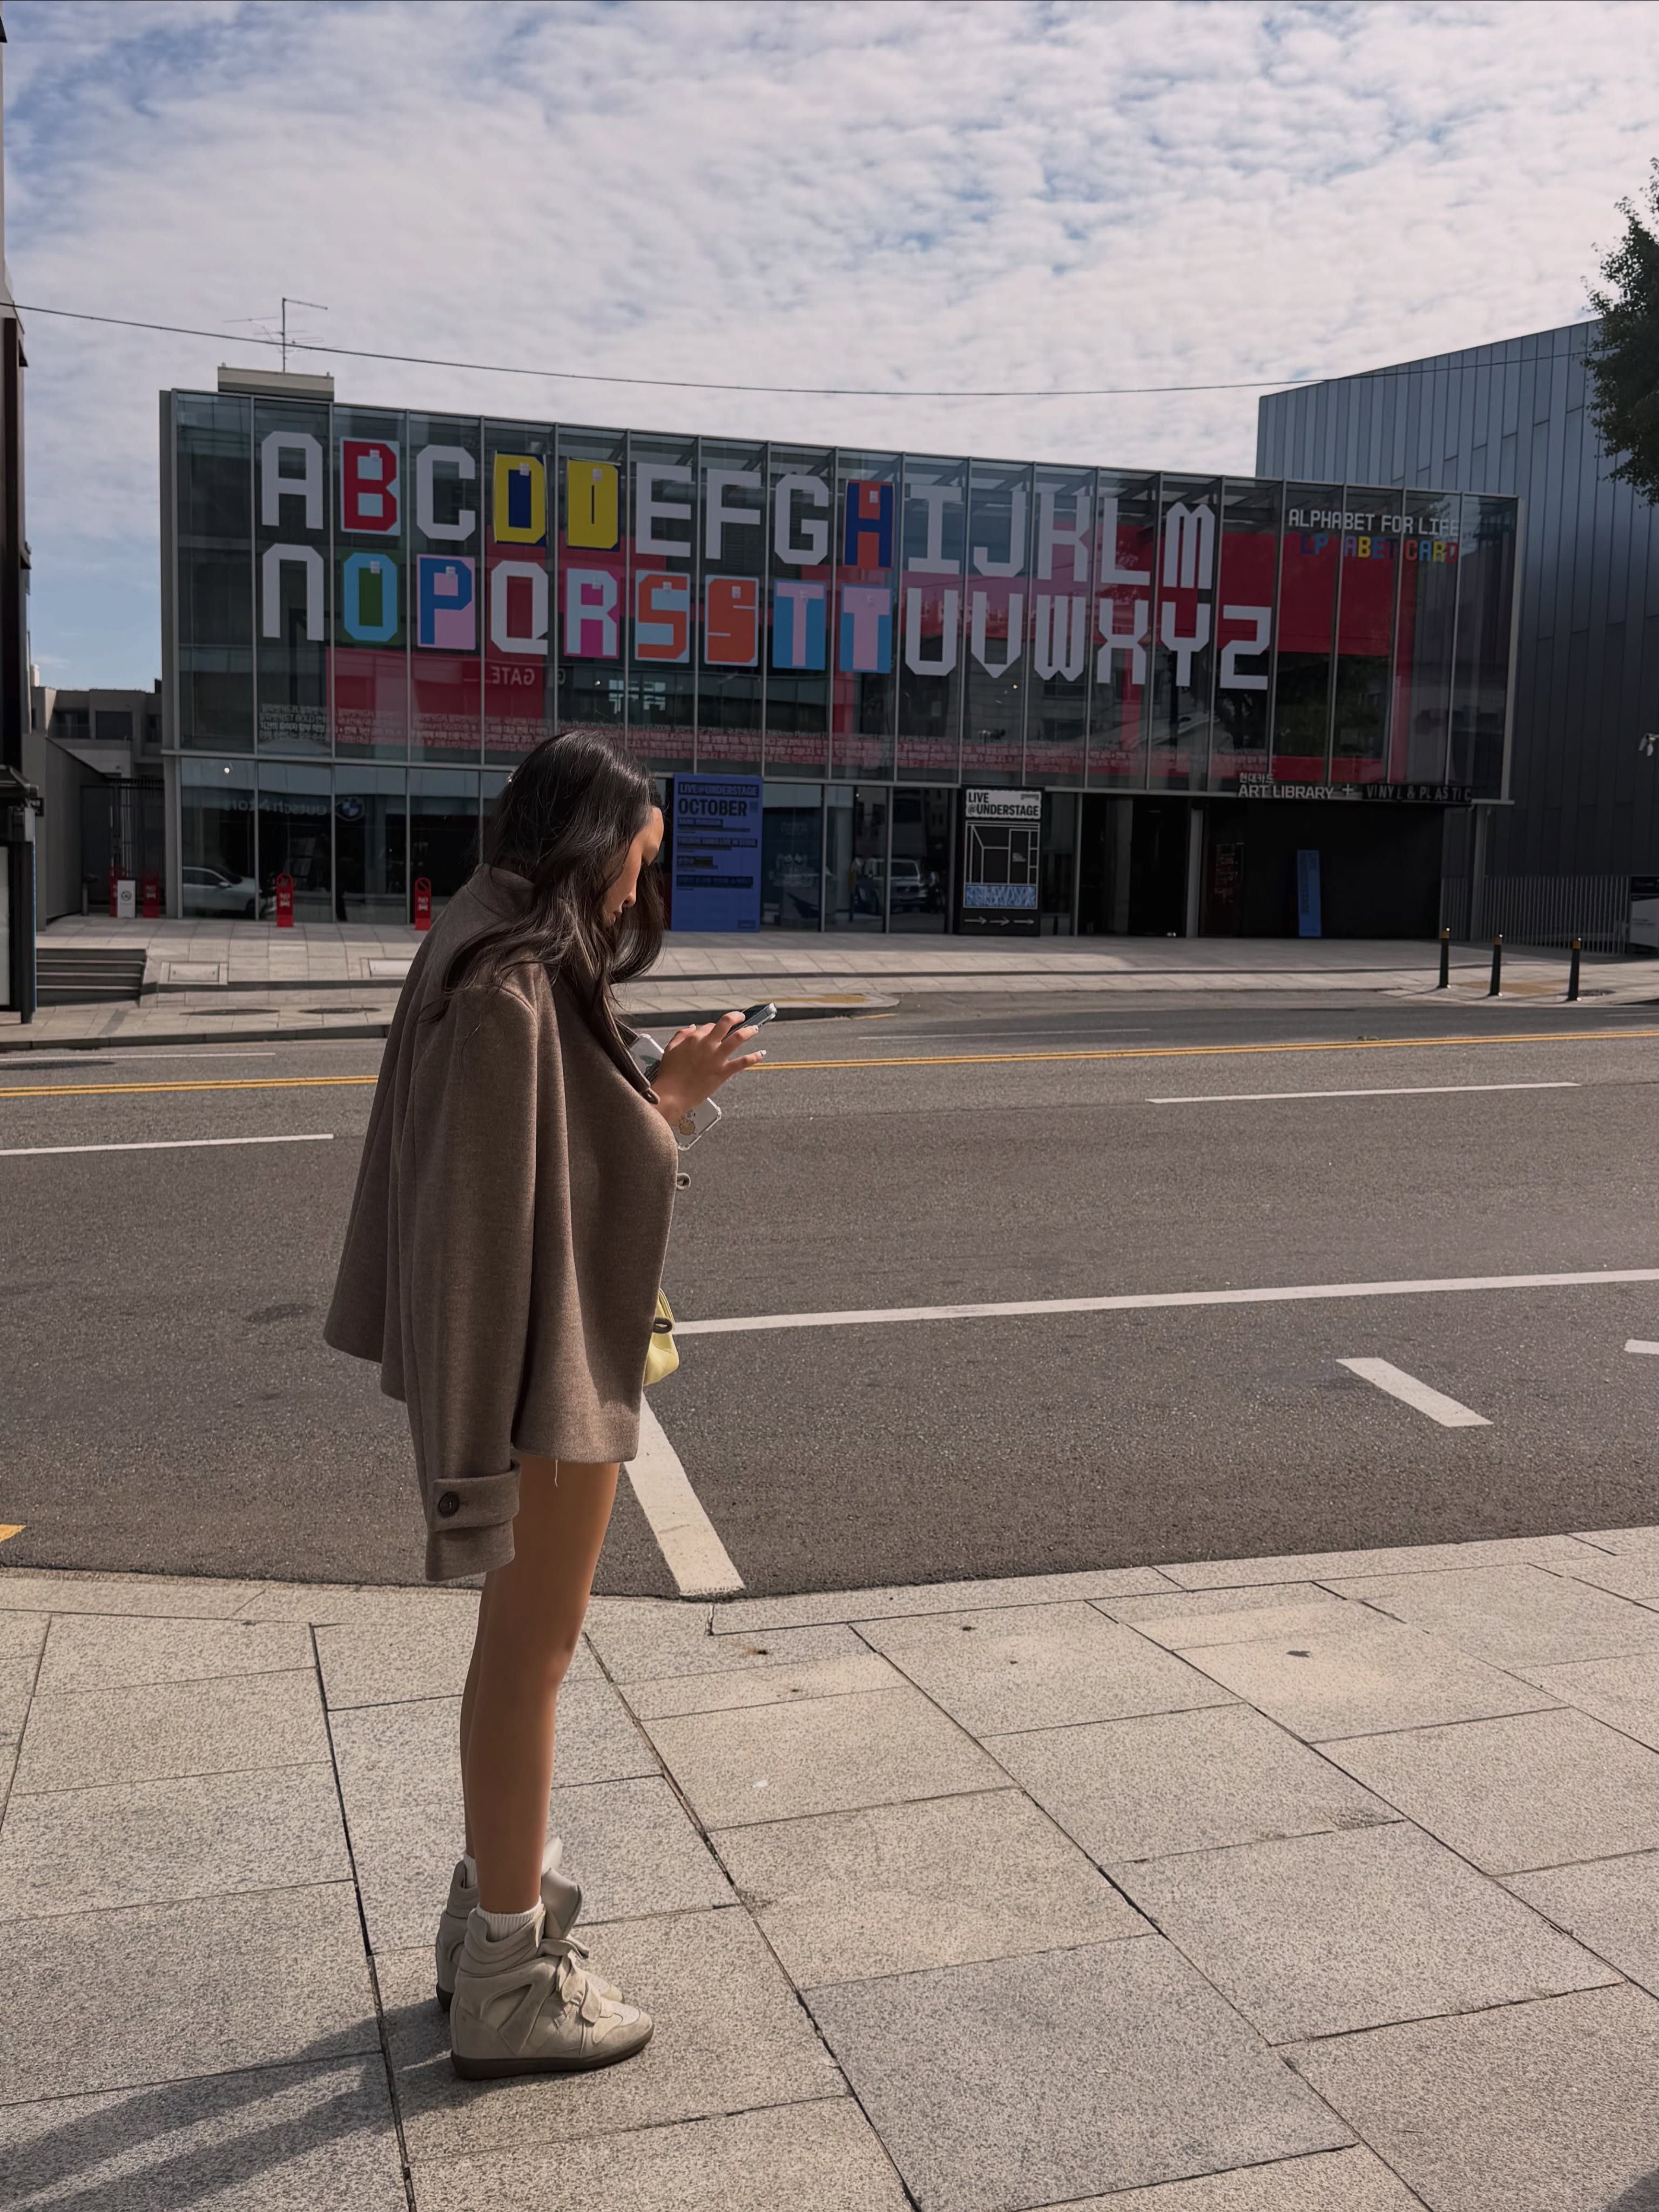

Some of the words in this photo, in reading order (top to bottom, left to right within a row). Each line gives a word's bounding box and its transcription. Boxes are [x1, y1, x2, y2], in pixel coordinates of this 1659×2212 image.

[1289, 509, 1375, 530] ALPHABET
[1381, 515, 1413, 534] FOR
[1418, 517, 1459, 536] LIFE
[1405, 539, 1458, 563] CARD
[968, 792, 989, 803] LIVE
[1238, 785, 1269, 798] ART
[1273, 785, 1334, 799] LIBRARY
[1367, 785, 1402, 800] VINYL
[1419, 786, 1471, 802] PLASTIC
[679, 798, 747, 817] OCTOBER
[968, 804, 1039, 817] @UNDERSTAGE
